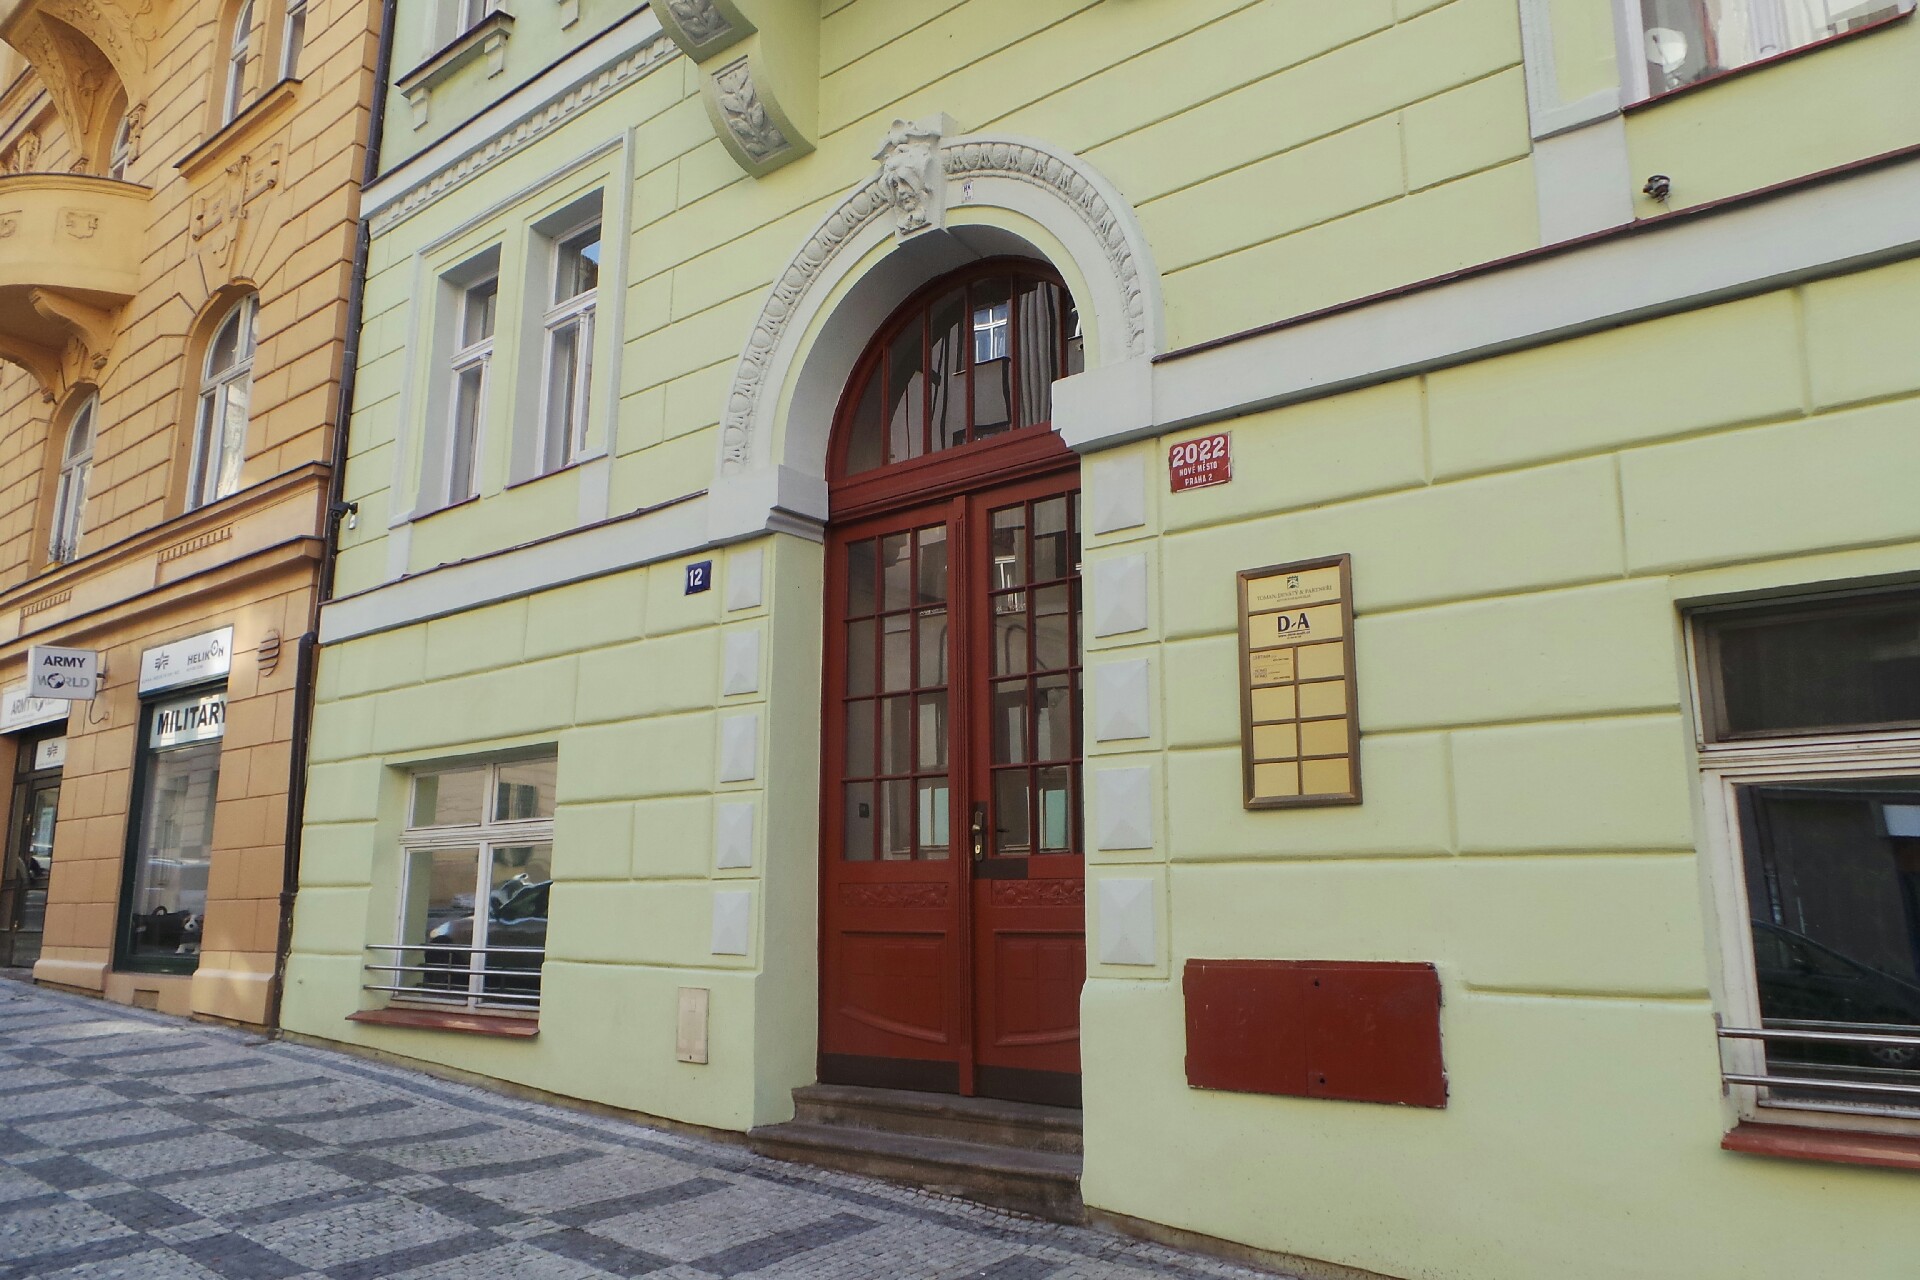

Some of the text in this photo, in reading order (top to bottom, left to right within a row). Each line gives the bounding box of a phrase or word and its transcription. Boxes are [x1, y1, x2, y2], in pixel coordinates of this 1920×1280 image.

[1172, 436, 1225, 468] 2022
[1179, 460, 1218, 477] NOVÉ MĚSTO
[1184, 473, 1213, 486] PRAHA 2
[690, 567, 703, 587] 12
[43, 655, 86, 668] ARMY
[187, 639, 224, 665] HELIKON
[157, 700, 226, 736] MILITARY
